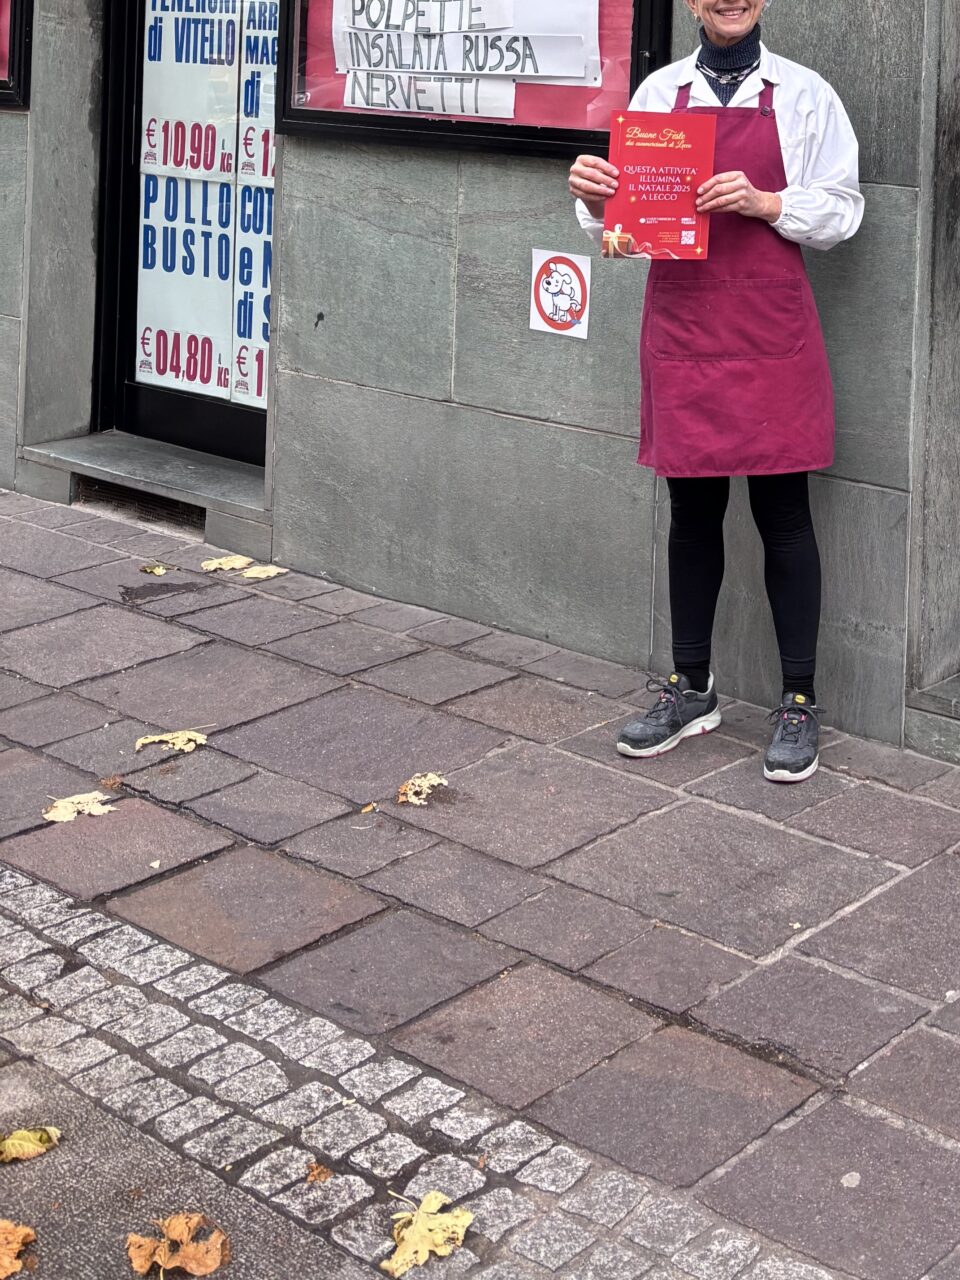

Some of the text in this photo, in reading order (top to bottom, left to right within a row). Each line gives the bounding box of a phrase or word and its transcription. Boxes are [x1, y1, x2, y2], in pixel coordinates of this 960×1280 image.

[147, 17, 235, 66] di VITELLO
[349, 33, 539, 73] INSALATA RUSSA
[243, 71, 261, 118] di
[350, 72, 480, 113] NERVETTI
[146, 118, 216, 170] € 10,90
[243, 126, 255, 158] €
[626, 126, 685, 140] Buone Feste
[220, 151, 232, 173] KG
[624, 165, 698, 175] QUESTA ATTIVITA'
[640, 175, 681, 183] ILLUMINA
[144, 174, 231, 229] POLLO
[672, 184, 690, 192] 2025
[142, 224, 230, 281] BUSTO
[239, 247, 252, 286] e
[237, 291, 253, 339] di
[140, 326, 212, 385] € 04,80
[236, 345, 248, 377] €
[216, 365, 229, 389] KG
